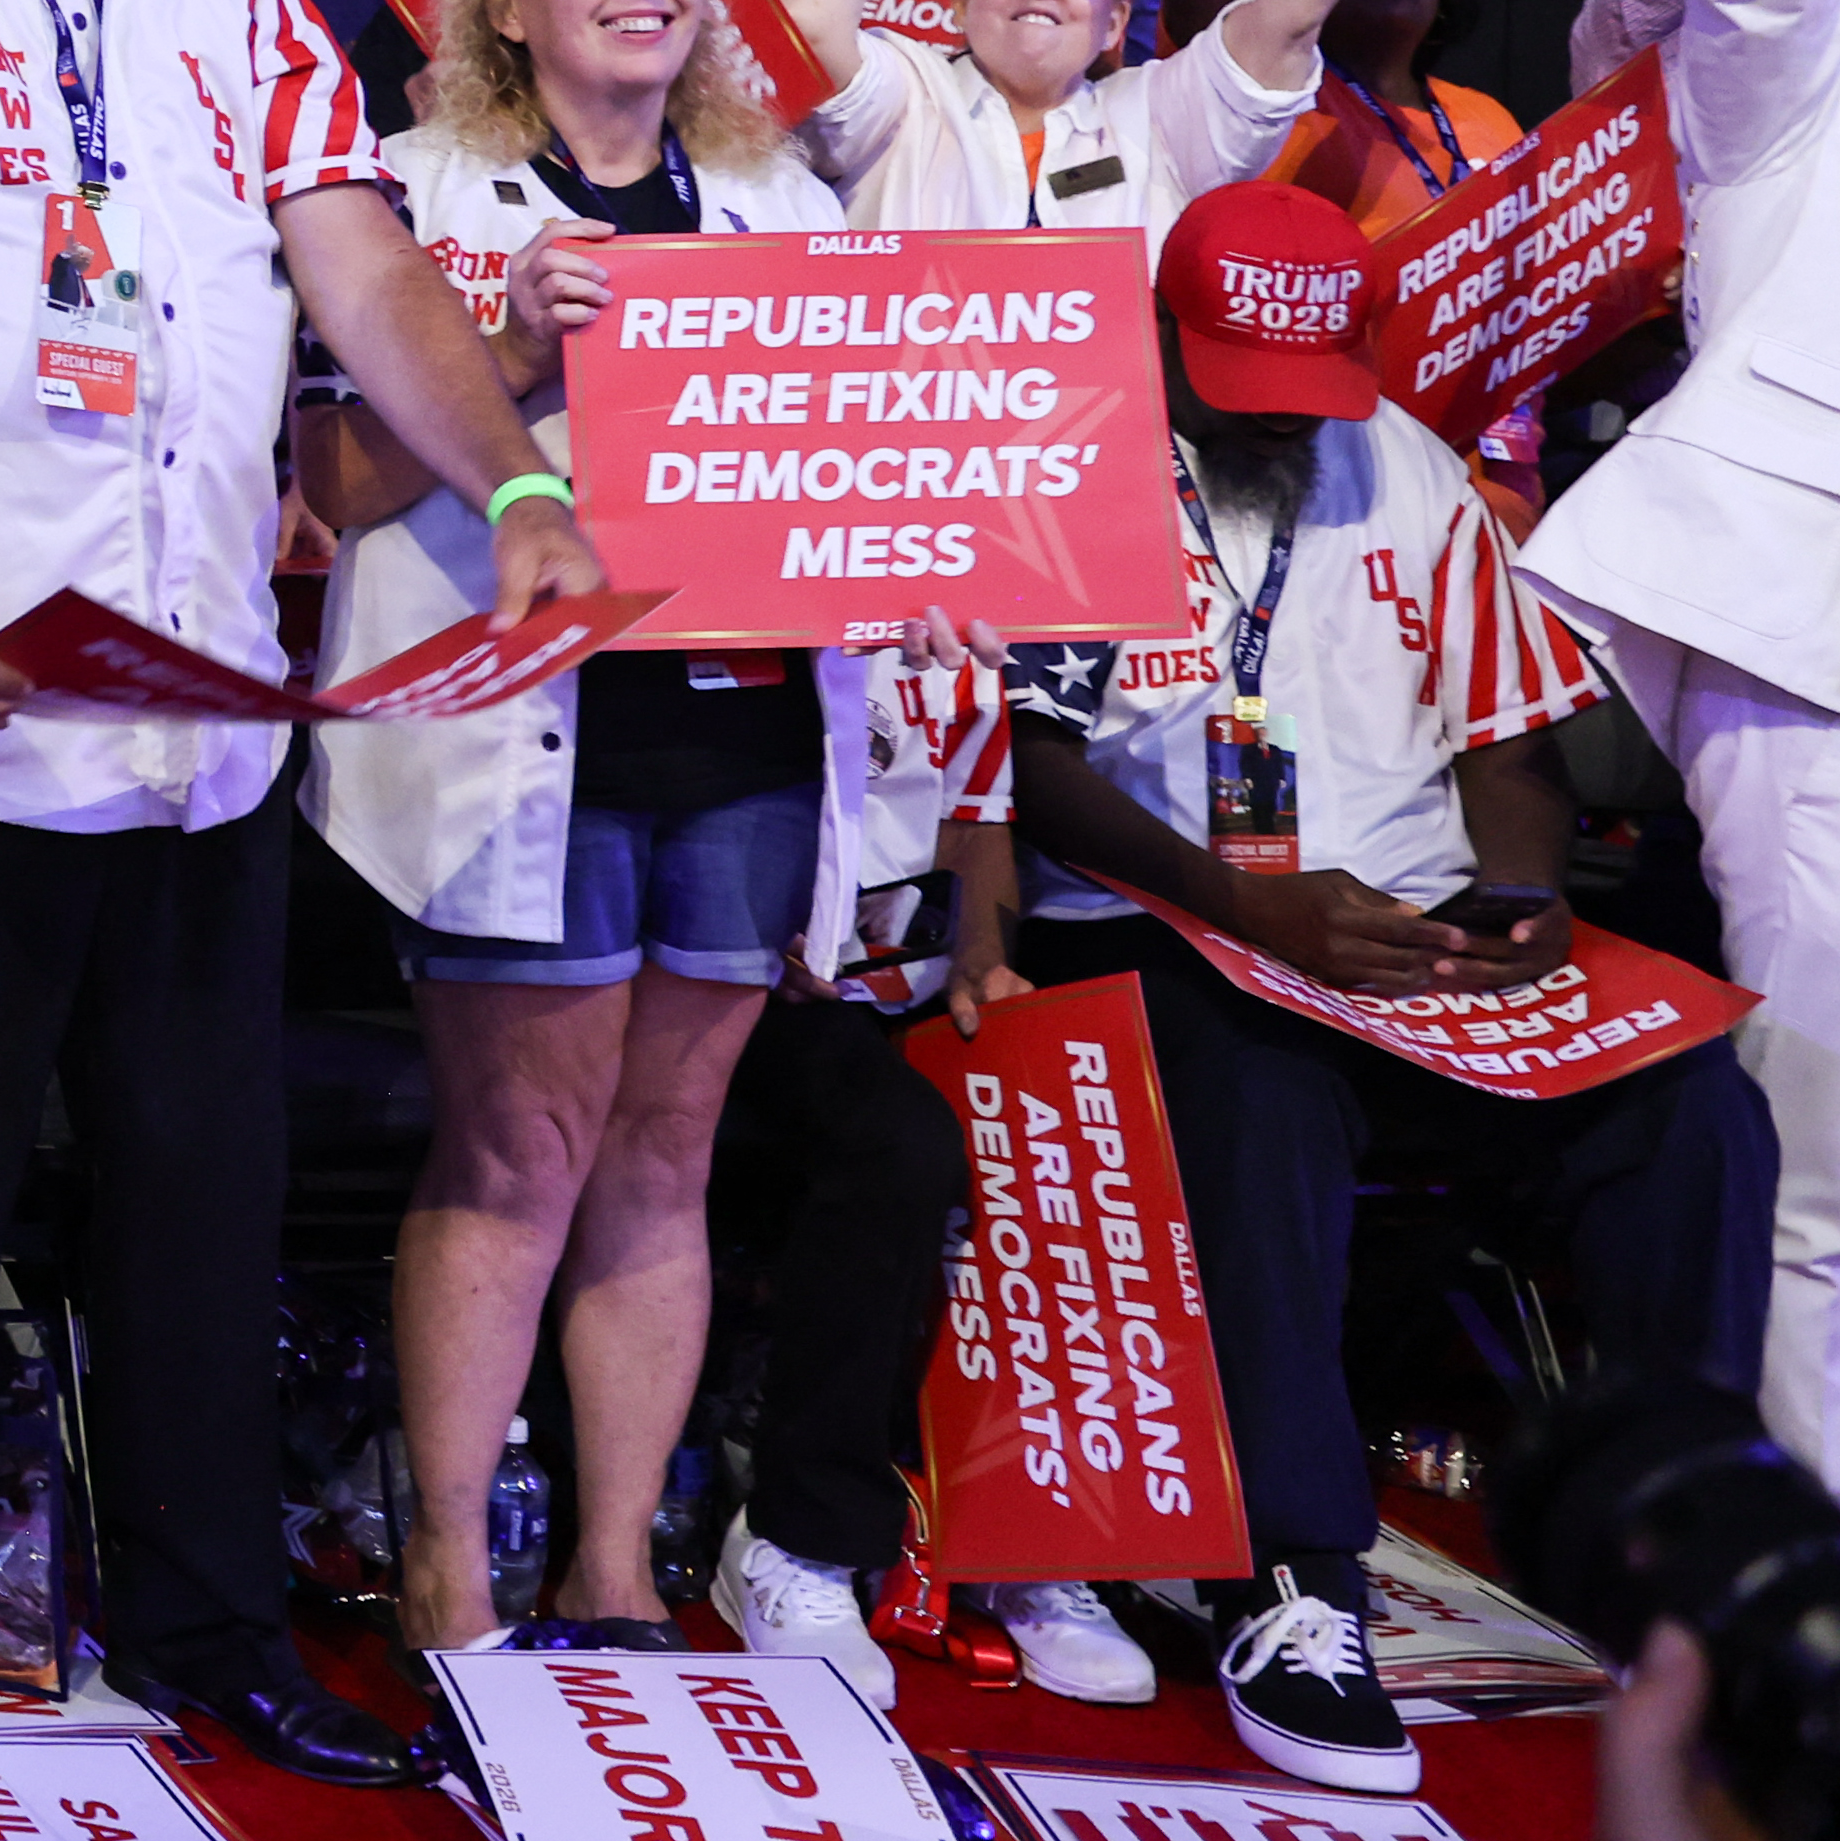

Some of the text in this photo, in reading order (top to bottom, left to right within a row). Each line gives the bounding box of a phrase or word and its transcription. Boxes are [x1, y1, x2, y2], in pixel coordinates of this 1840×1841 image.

[90, 96, 104, 160] DALLAS
[56, 201, 74, 230] 1
[1397, 107, 1640, 304] REPUBLICANS
[807, 235, 901, 255] DALLAS
[1427, 172, 1631, 336] ARE FIXING
[1219, 259, 1363, 302] TRUMP
[1415, 208, 1656, 393] DEMOCRATS'
[619, 290, 1096, 349] REPUBLICANS
[1227, 296, 1349, 332] 2028
[49, 352, 125, 376] SPECIAL GUEST
[1485, 302, 1591, 392] MESS
[667, 368, 1058, 427] ARE FIXING
[644, 444, 1099, 504] DEMOCRATS'
[780, 524, 975, 579] MESS
[843, 621, 925, 641] 202
[1118, 647, 1219, 690] JOES
[1465, 993, 1589, 1045] ARE
[966, 1072, 1071, 1509] DEMOCRATS'
[1019, 1090, 1123, 1473] ARE FIXING
[1065, 1040, 1192, 1517] REPUBLICANS
[1167, 1222, 1201, 1317] DALLAS
[677, 1673, 820, 1798] KEEP
[486, 1761, 516, 1813] 2026
[890, 1758, 939, 1821] DALLAS
